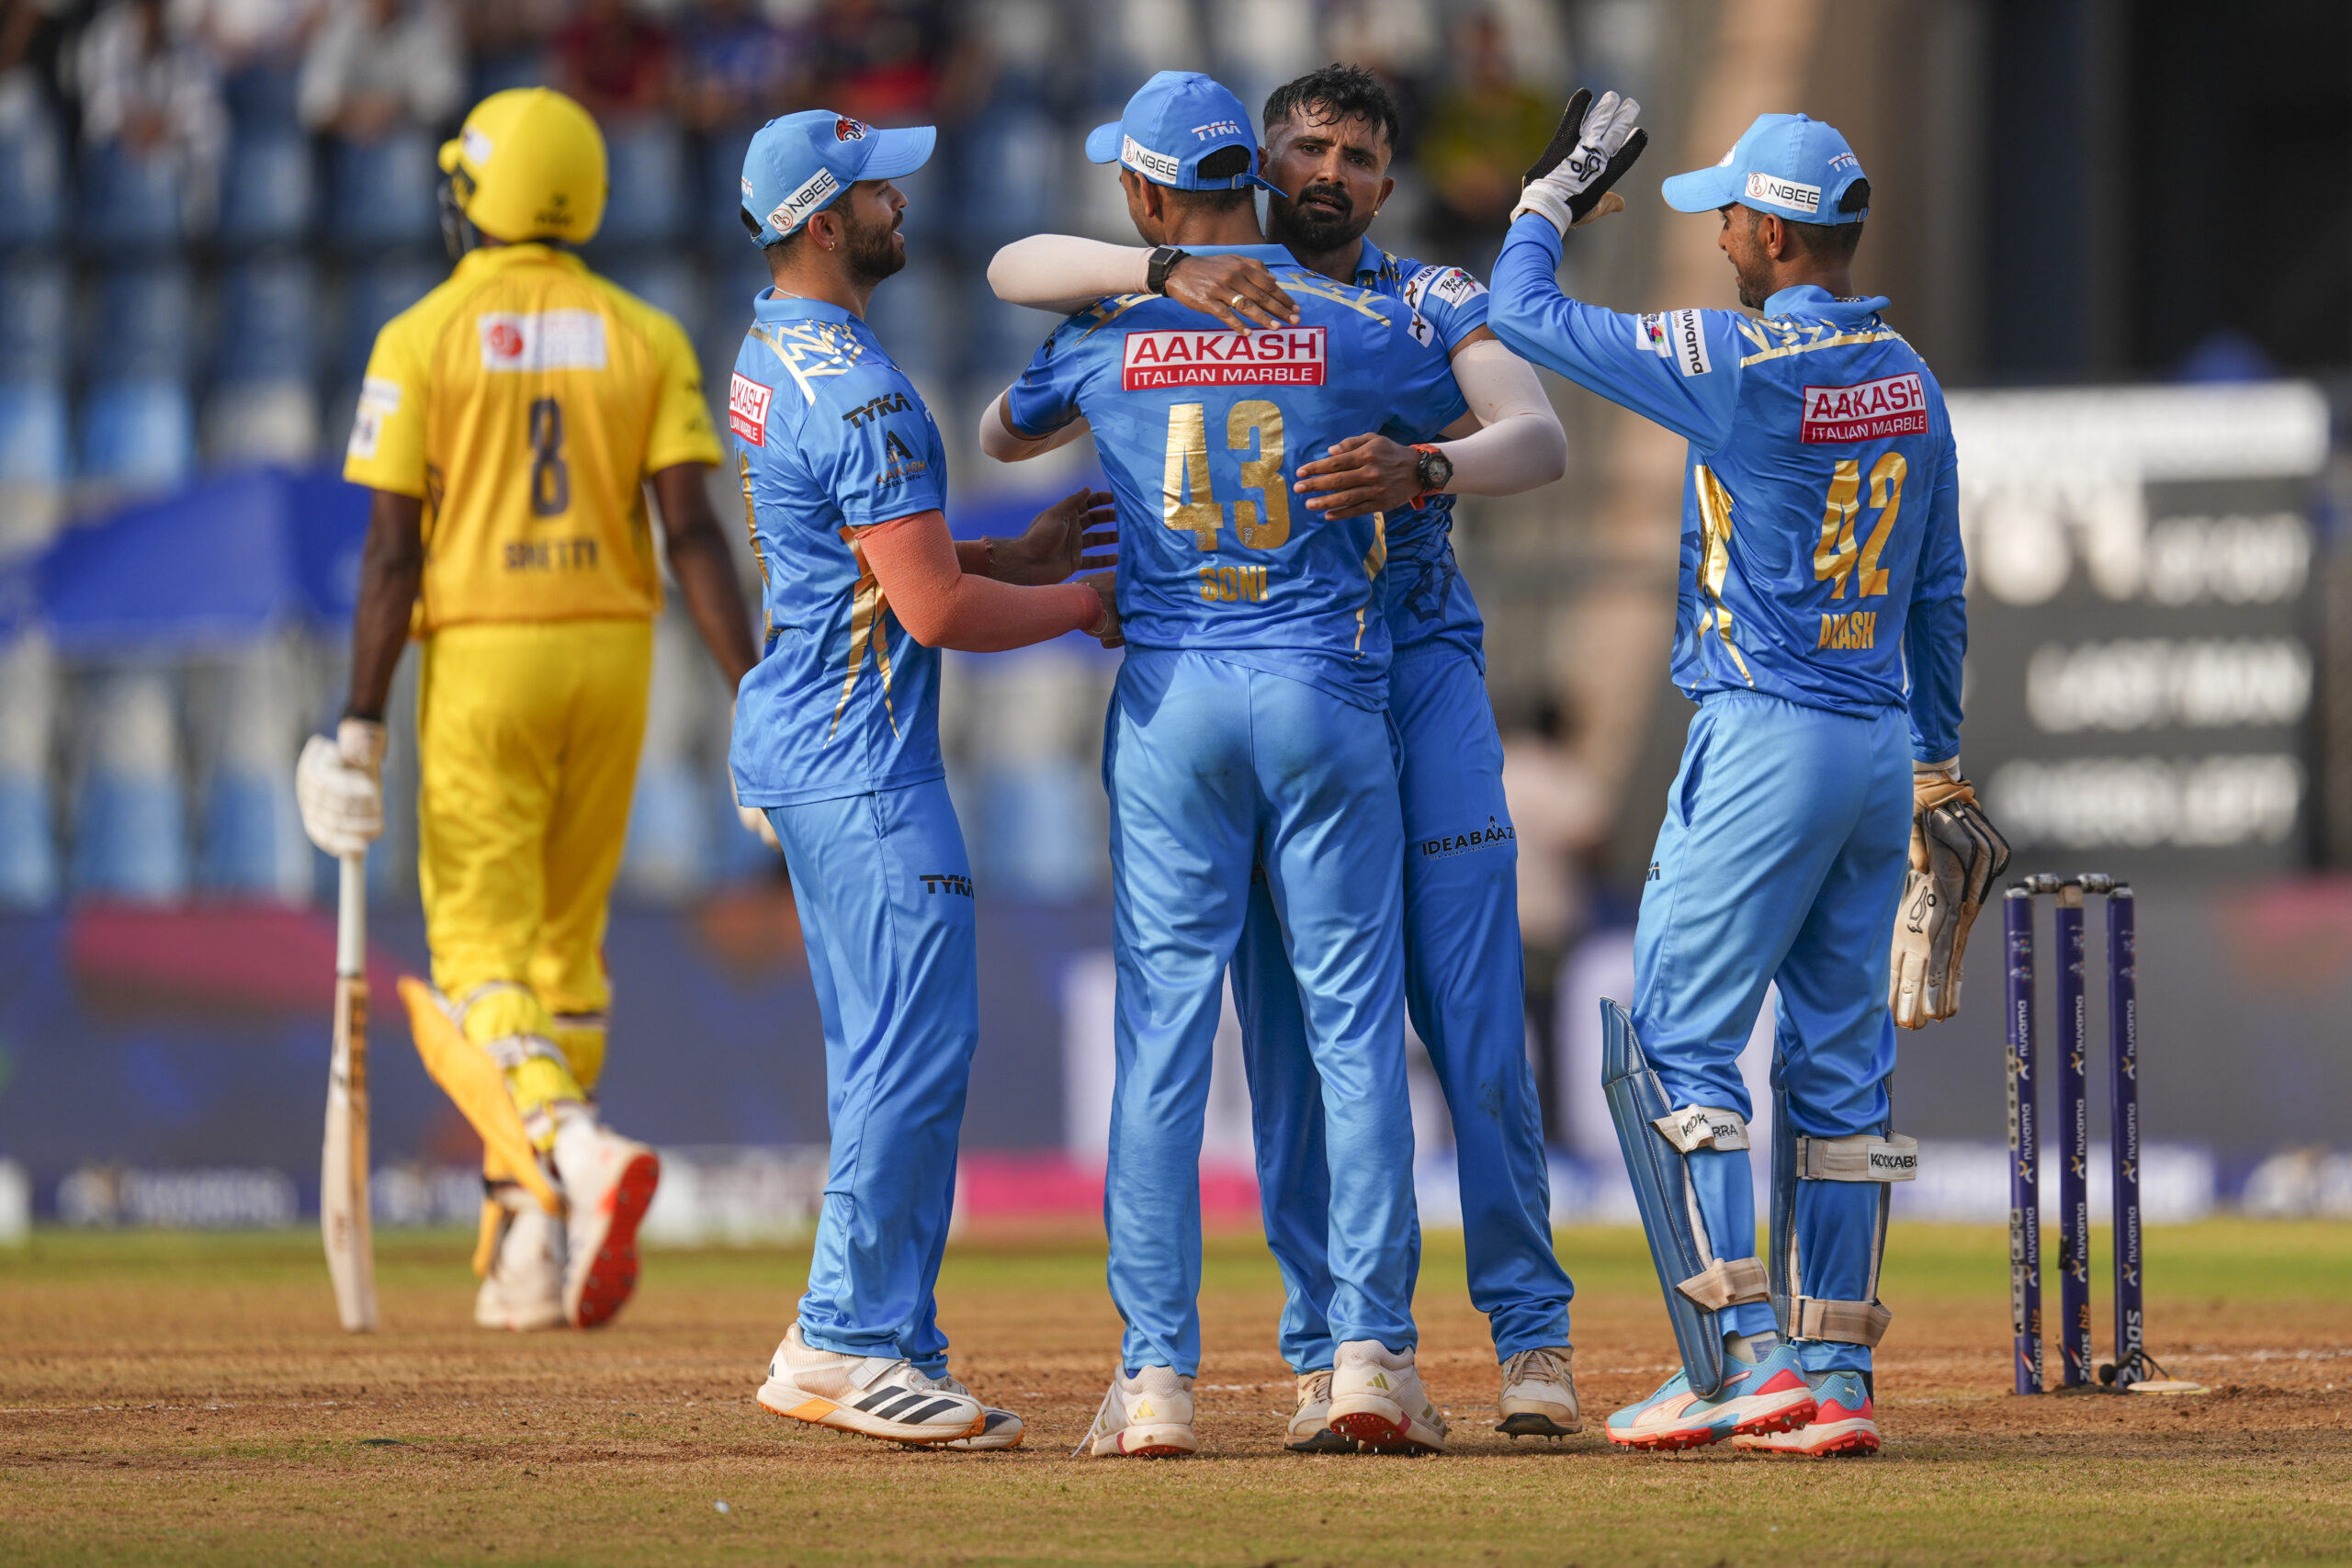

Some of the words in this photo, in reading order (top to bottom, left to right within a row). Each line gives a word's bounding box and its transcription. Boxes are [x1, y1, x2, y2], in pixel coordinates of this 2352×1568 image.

[1191, 120, 1241, 141] TYKA
[1136, 150, 1178, 176] NBEE
[789, 172, 835, 213] NBEE
[1769, 183, 1820, 206] NBEE
[1132, 333, 1316, 364] AAKASH
[1681, 310, 1704, 374] nuvama
[730, 379, 764, 420] AKASH
[1134, 368, 1216, 386] ITALIAN
[1223, 367, 1313, 382] MARBLE
[1811, 378, 1923, 419] AAKASH
[842, 392, 913, 429] TYKA
[1812, 423, 1869, 440] ITALIAN
[1872, 415, 1924, 436] MARBLE
[528, 397, 571, 518] 8
[1162, 400, 1291, 550] 43
[1814, 452, 1908, 600] 42
[1199, 565, 1270, 603] SONI
[1816, 611, 1877, 650] AKASH
[1422, 827, 1515, 856] IDEABAAZ
[2018, 999, 2029, 1056] nuvama
[2075, 995, 2084, 1052] nuvama
[2126, 999, 2135, 1056] nuvama
[2021, 1103, 2033, 1160] nuvama
[2076, 1099, 2086, 1156] nuvama
[2127, 1103, 2136, 1160] nuvama
[2026, 1207, 2037, 1264] nuvama
[2076, 1202, 2086, 1259] nuvama
[2128, 1206, 2137, 1263] nuvama
